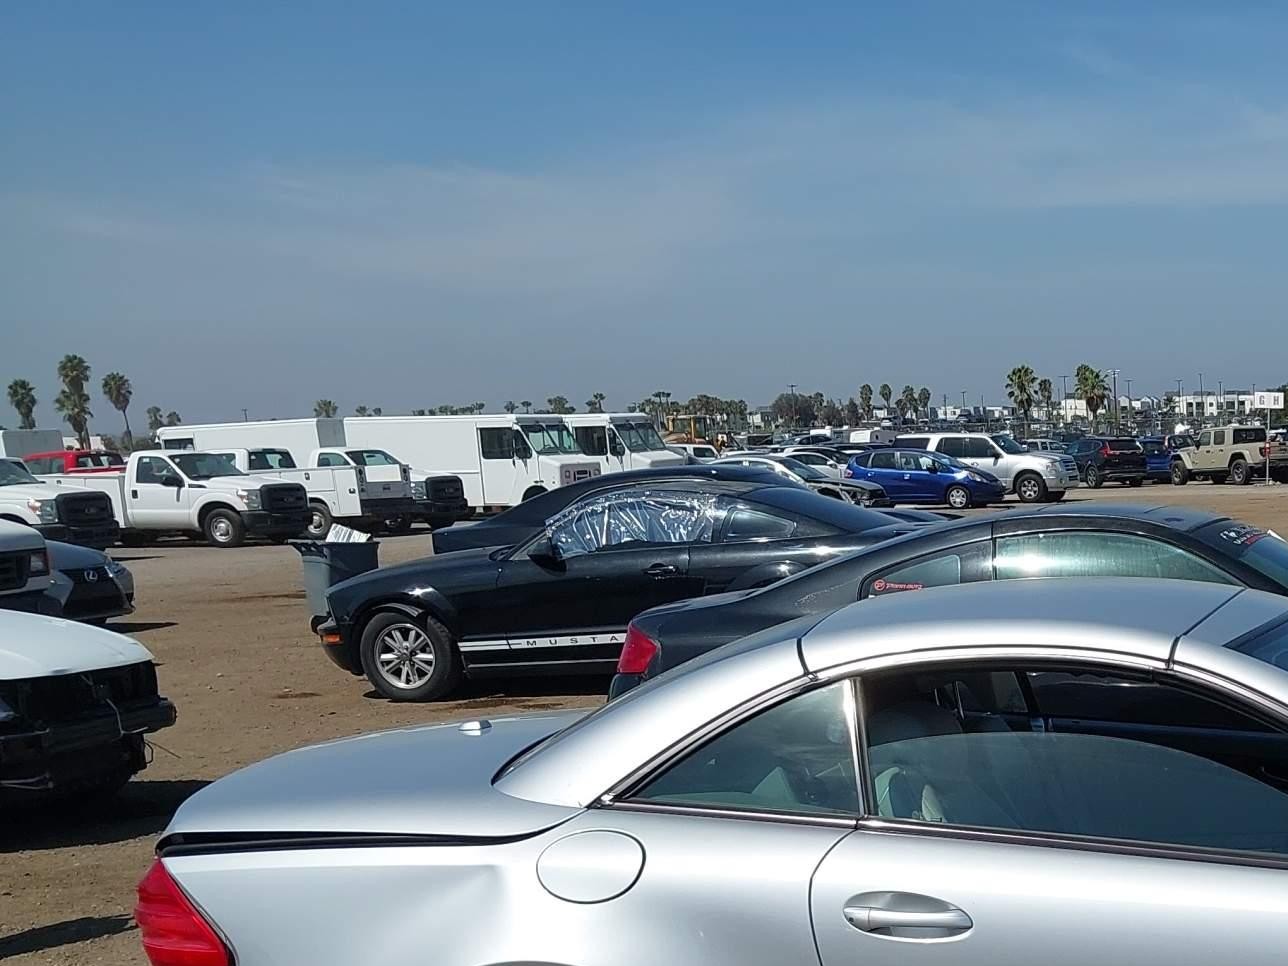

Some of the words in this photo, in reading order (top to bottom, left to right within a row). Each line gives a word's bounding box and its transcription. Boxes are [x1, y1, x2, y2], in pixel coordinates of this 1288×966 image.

[1259, 395, 1265, 406] G
[1273, 395, 1280, 406] H
[526, 635, 619, 647] MUSTA
